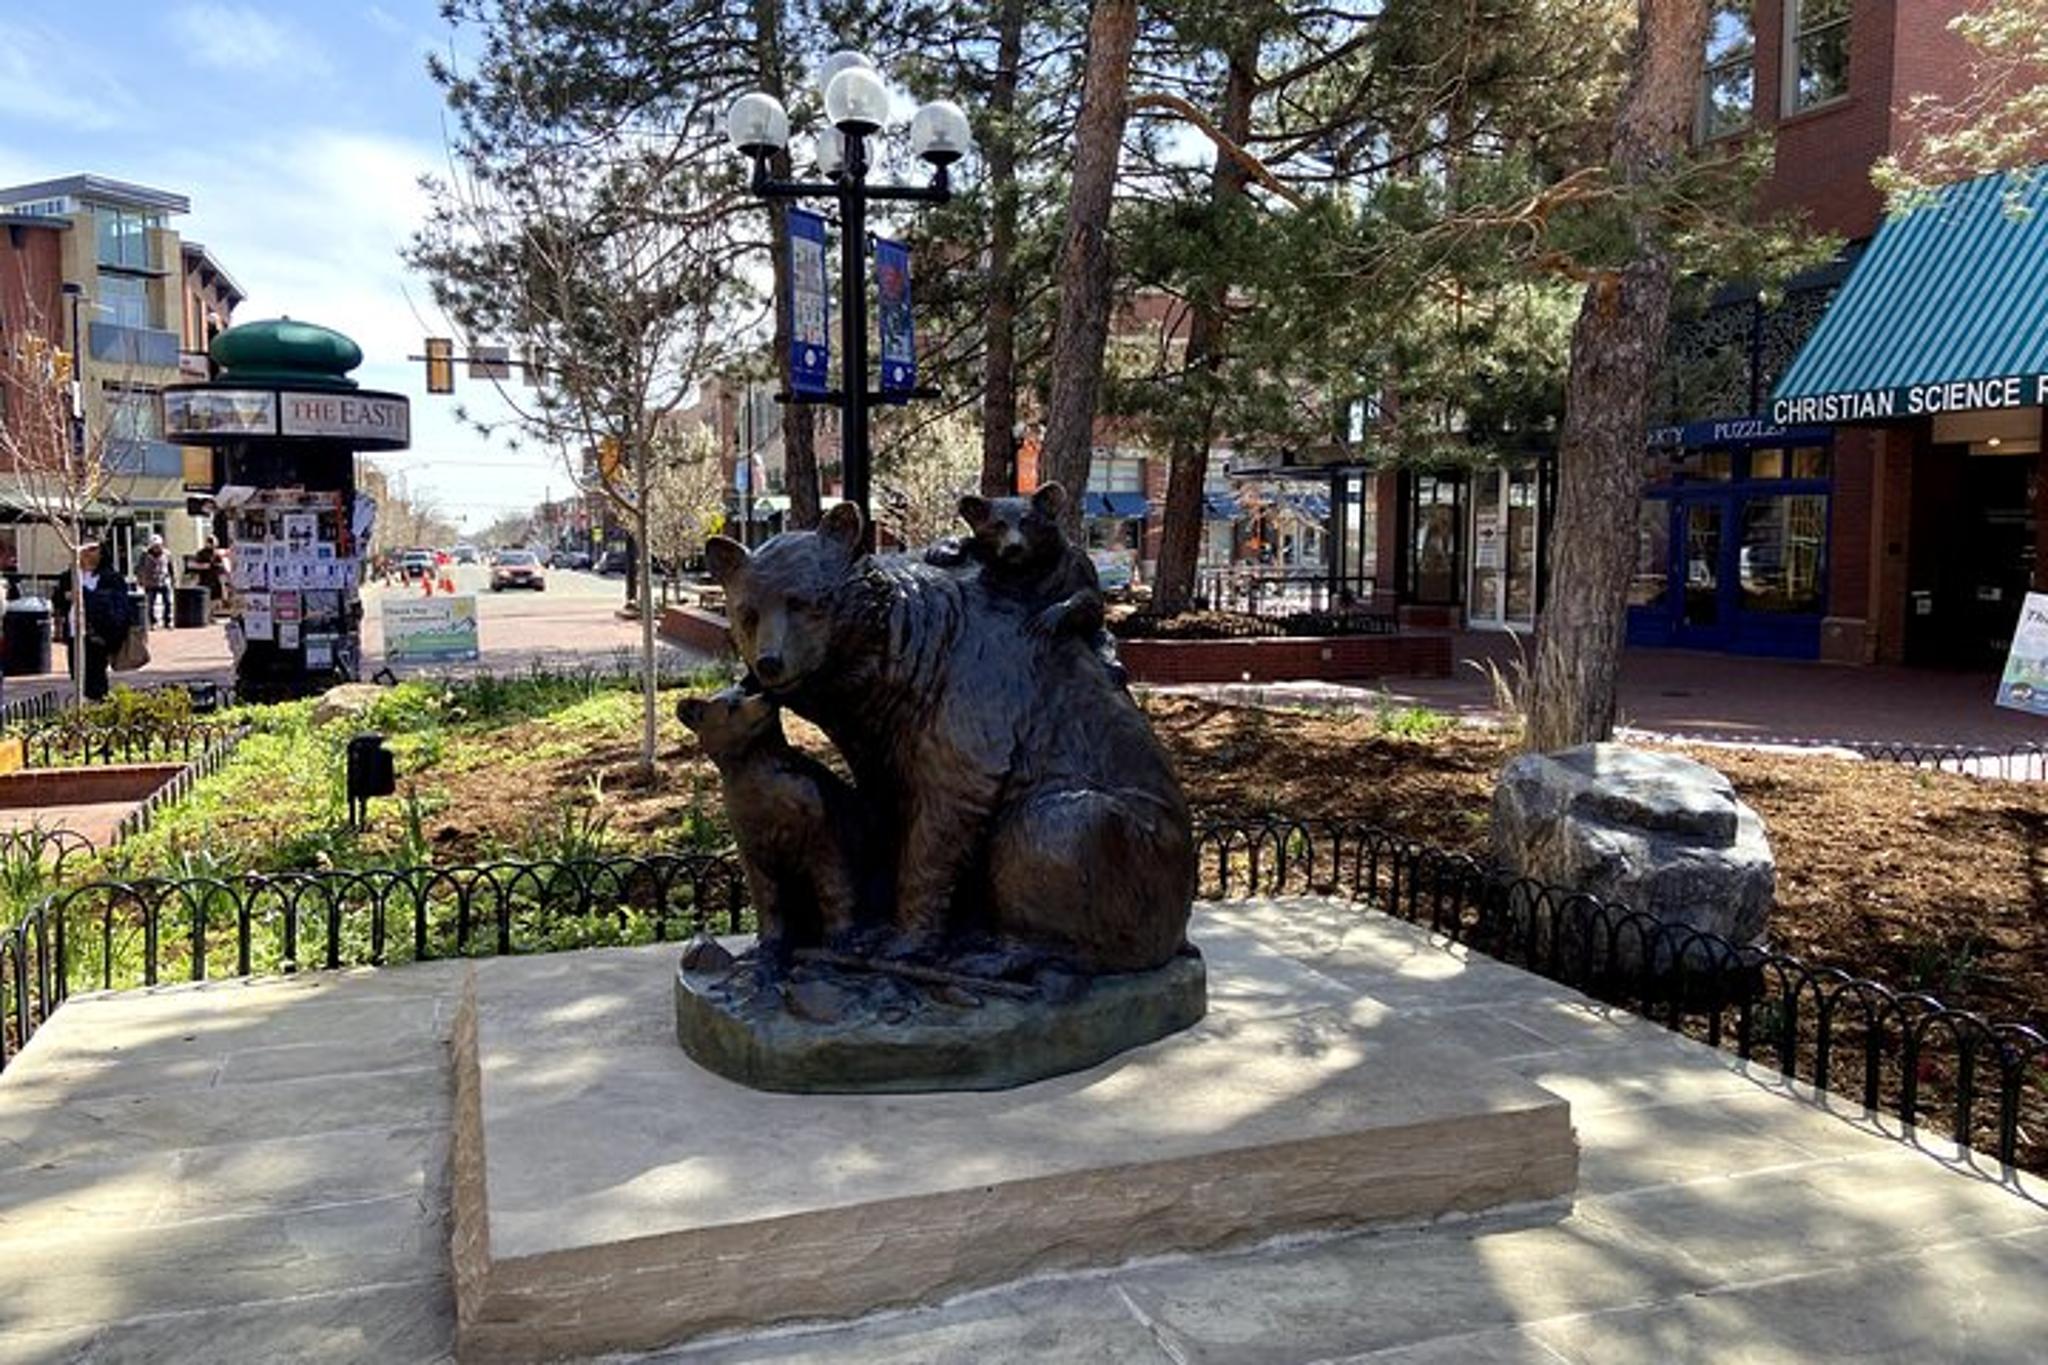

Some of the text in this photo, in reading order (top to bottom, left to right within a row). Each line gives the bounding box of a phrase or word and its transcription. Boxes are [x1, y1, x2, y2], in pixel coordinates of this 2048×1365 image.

[292, 402, 335, 421] THE
[1774, 390, 1894, 424] CHRISTIAN
[1908, 378, 2021, 414] SCIENCE
